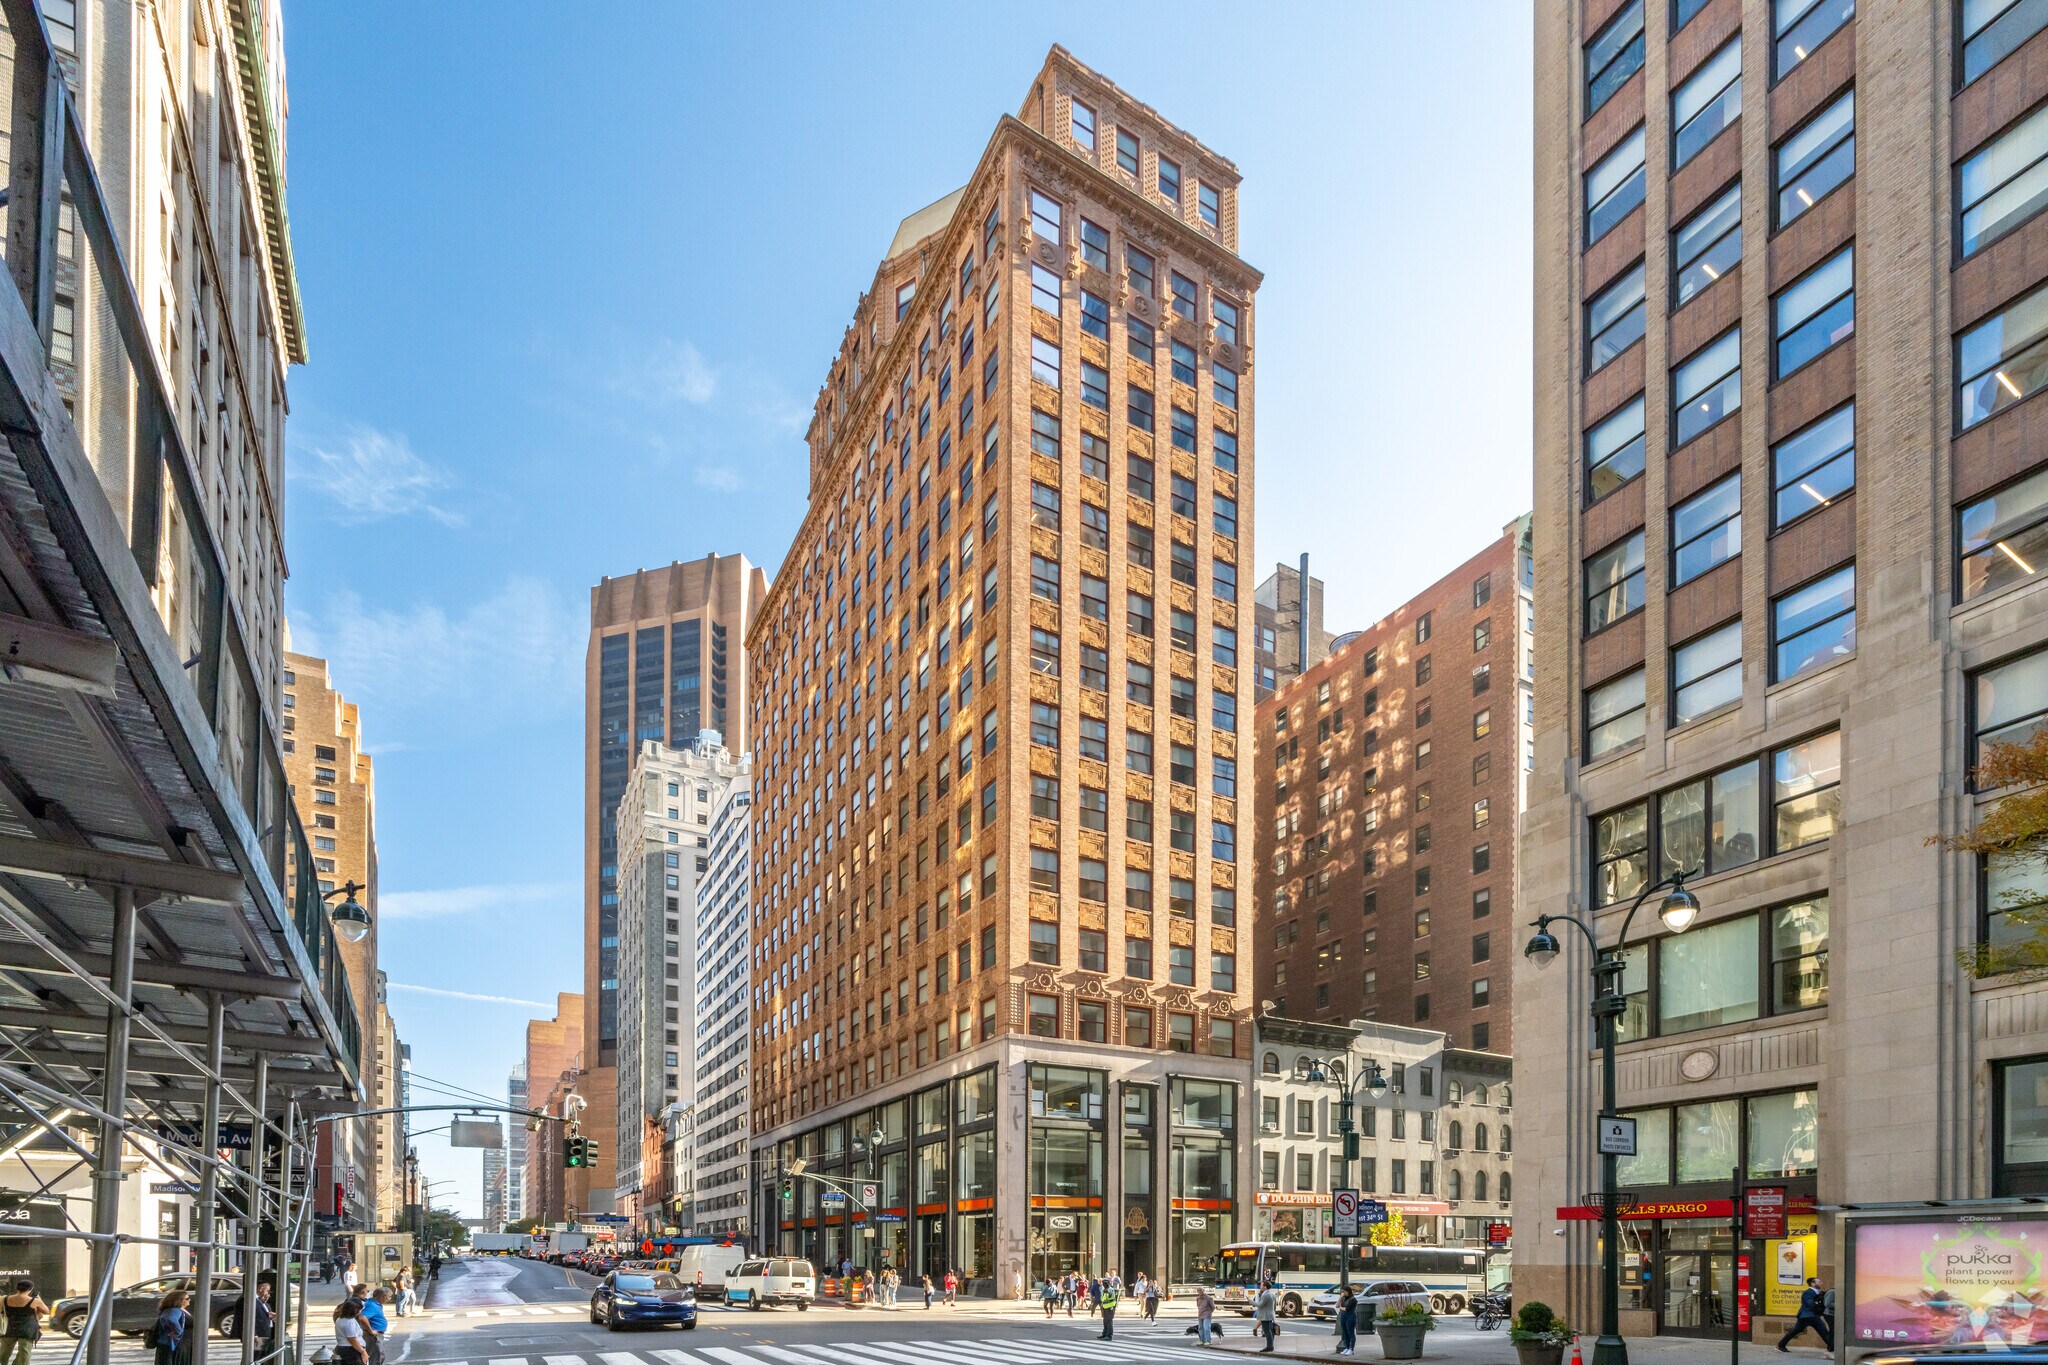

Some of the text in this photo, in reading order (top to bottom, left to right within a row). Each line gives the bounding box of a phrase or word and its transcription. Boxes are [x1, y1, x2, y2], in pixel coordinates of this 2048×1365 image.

[166, 1131, 227, 1144] Madin
[1271, 1193, 1314, 1204] DOLPHIN
[1659, 1204, 1708, 1213] FARGO
[1947, 1250, 2012, 1266] pukka
[1945, 1267, 2015, 1277] plant power
[1945, 1277, 1974, 1285] flows
[1993, 1279, 2015, 1287] you
